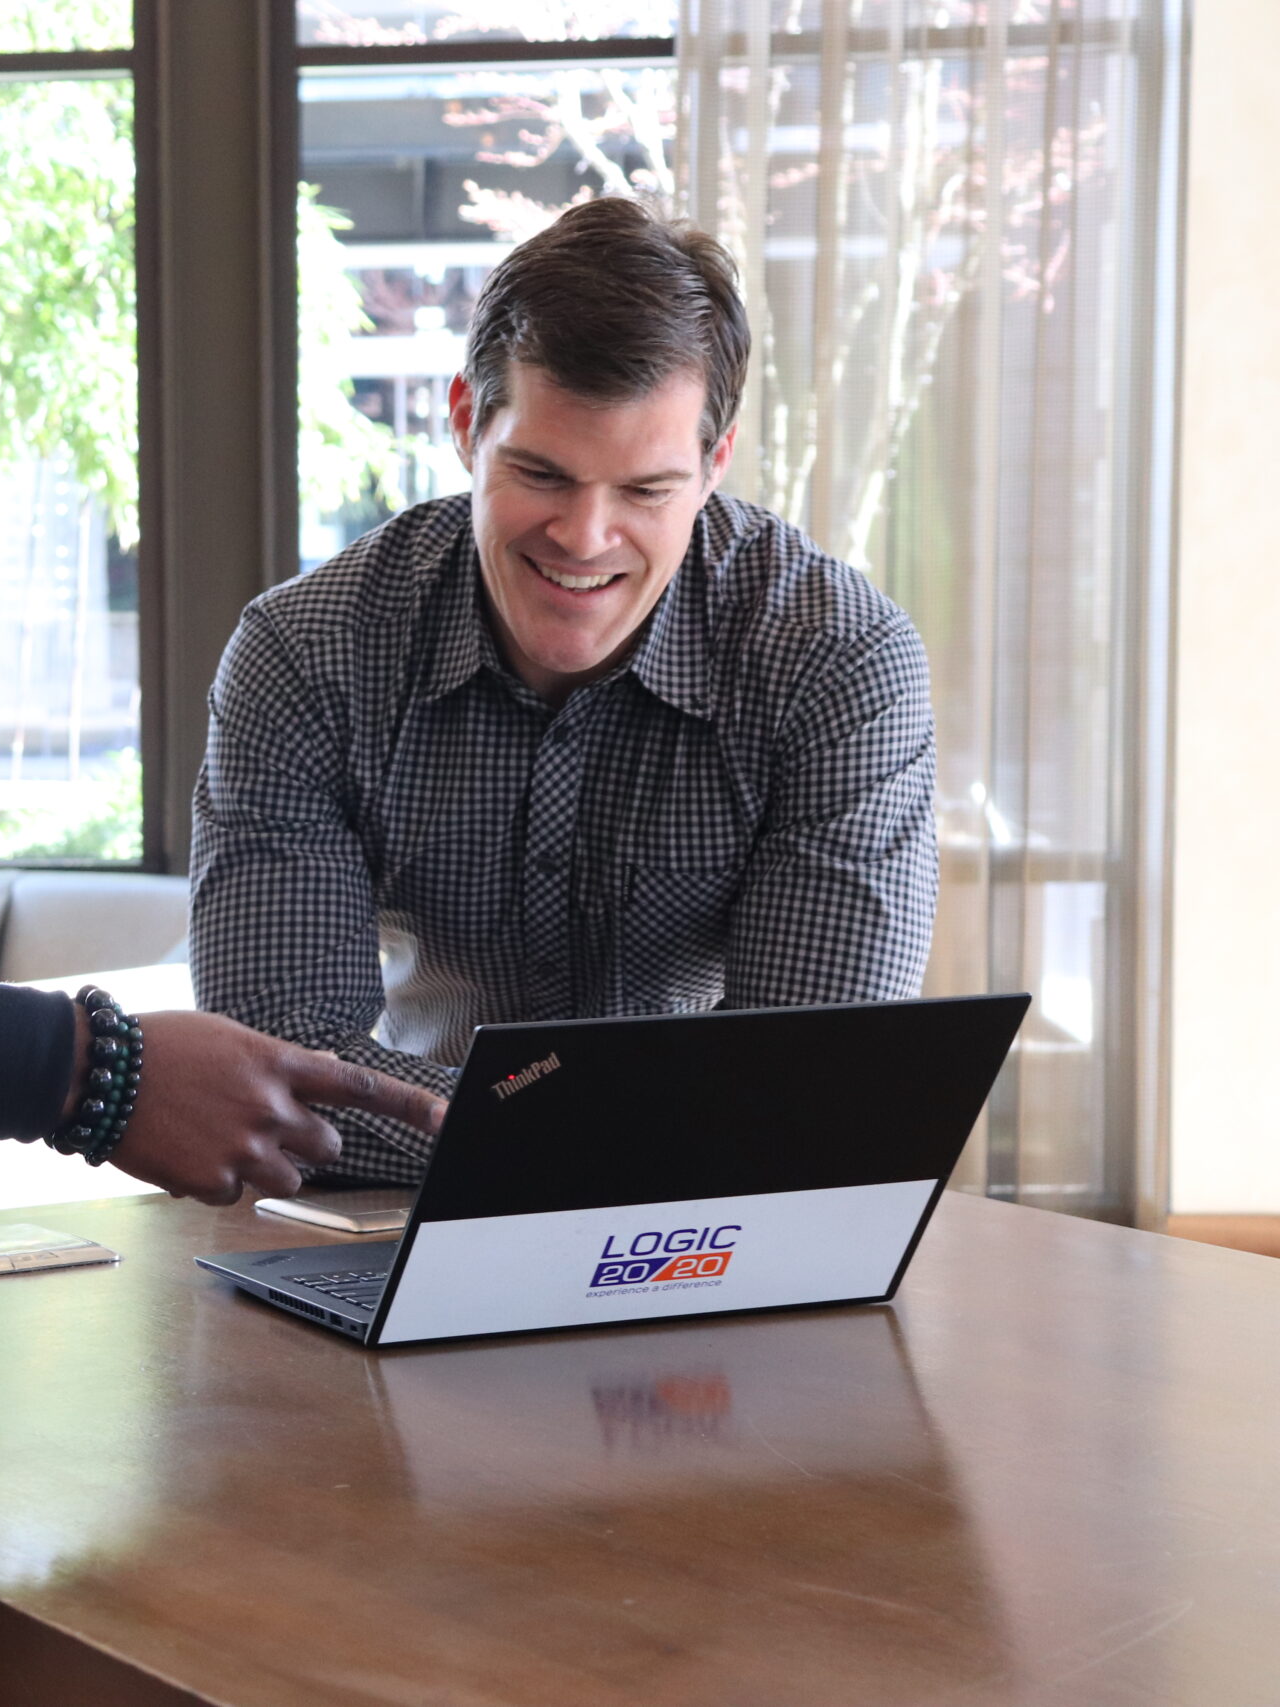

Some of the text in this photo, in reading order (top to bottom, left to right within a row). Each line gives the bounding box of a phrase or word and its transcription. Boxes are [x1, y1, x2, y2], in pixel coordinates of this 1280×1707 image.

[491, 1052, 561, 1099] ThinkPad
[600, 1225, 742, 1259] LOGIC
[585, 1279, 723, 1298] experience a difference
